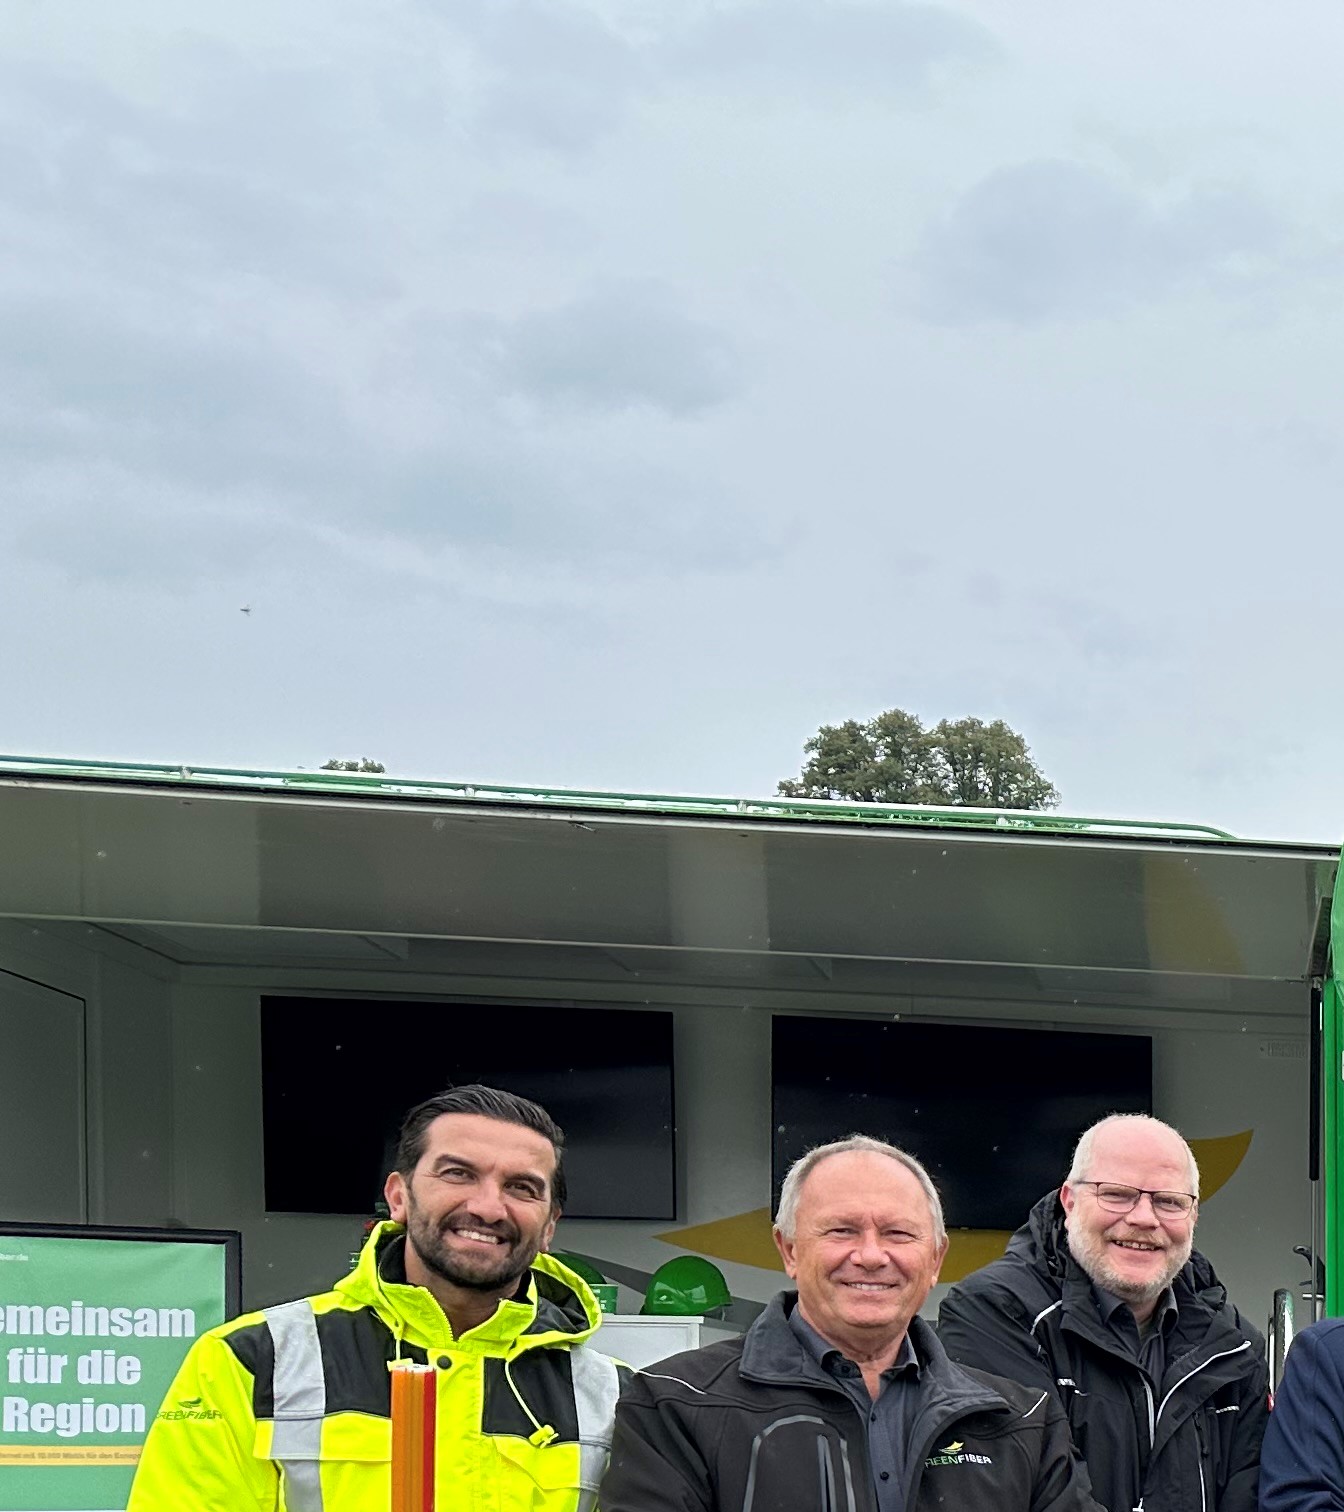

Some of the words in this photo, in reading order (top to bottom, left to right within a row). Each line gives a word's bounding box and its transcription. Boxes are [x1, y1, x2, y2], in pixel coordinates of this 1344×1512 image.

[0, 1300, 196, 1337] meinsam
[7, 1347, 67, 1384] für
[77, 1350, 141, 1385] die
[3, 1396, 146, 1438] Region
[157, 1410, 223, 1421] REENFIBER
